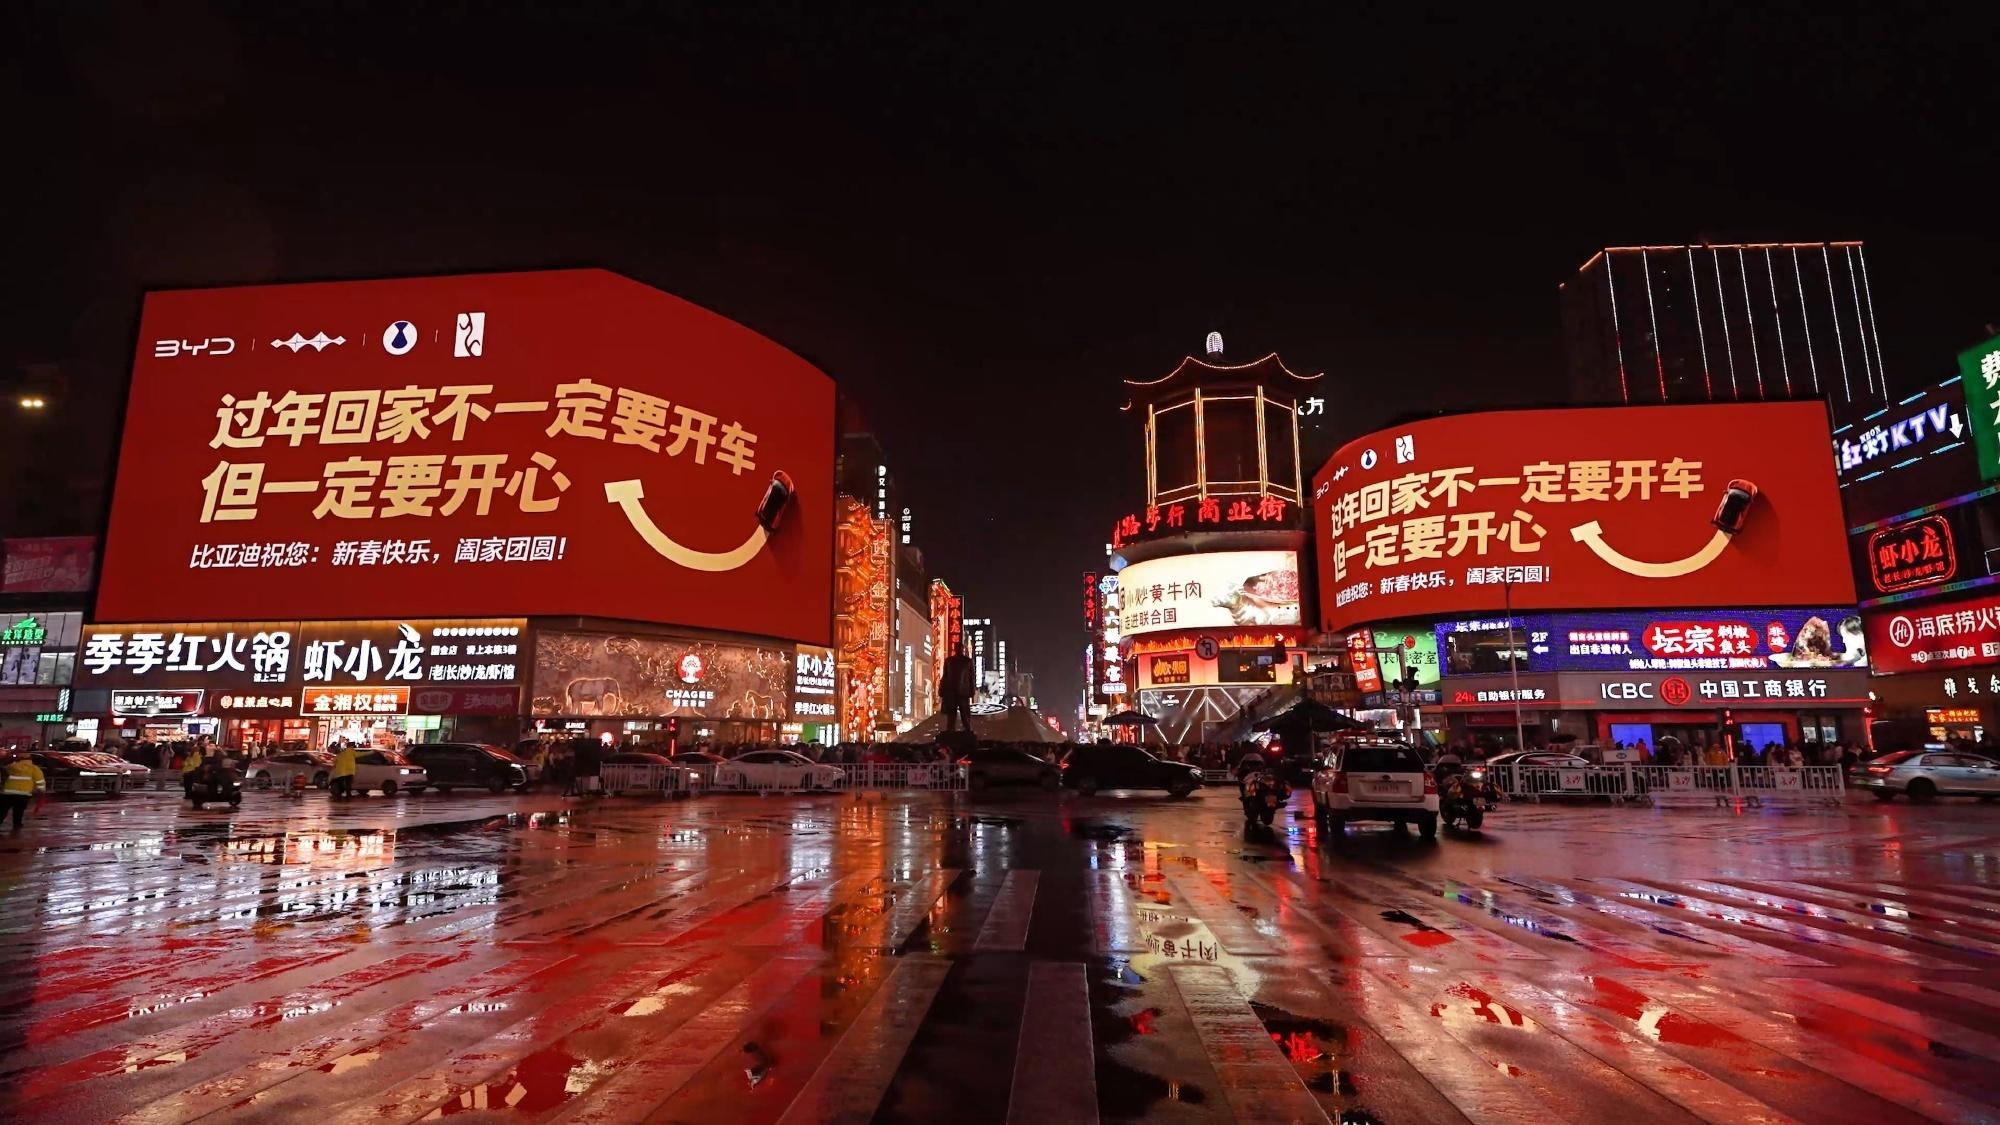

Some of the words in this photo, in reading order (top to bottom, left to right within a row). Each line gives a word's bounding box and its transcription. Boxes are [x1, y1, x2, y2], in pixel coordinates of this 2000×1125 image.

[155, 337, 235, 357] BYD
[209, 378, 758, 476] 过年回家不一定要开车
[199, 451, 572, 523] 但一定要开心
[1331, 457, 1705, 540] 过年回家不一定要开车
[1334, 509, 1548, 583] 但一定要开心
[1879, 526, 1944, 570] 虾小龙
[1531, 632, 1549, 643] 2F
[1651, 625, 1716, 654] 坛宗
[84, 632, 291, 675] 季季红火锅
[303, 623, 425, 682] 虾小龙
[665, 689, 714, 700] CHAGEE
[1455, 691, 1475, 703] 24h
[1478, 689, 1546, 702] 自助银行服务
[1601, 682, 1654, 699] ICBC
[1699, 679, 1827, 698] 中国工商银行
[1944, 674, 2000, 699] 雅戈尔
